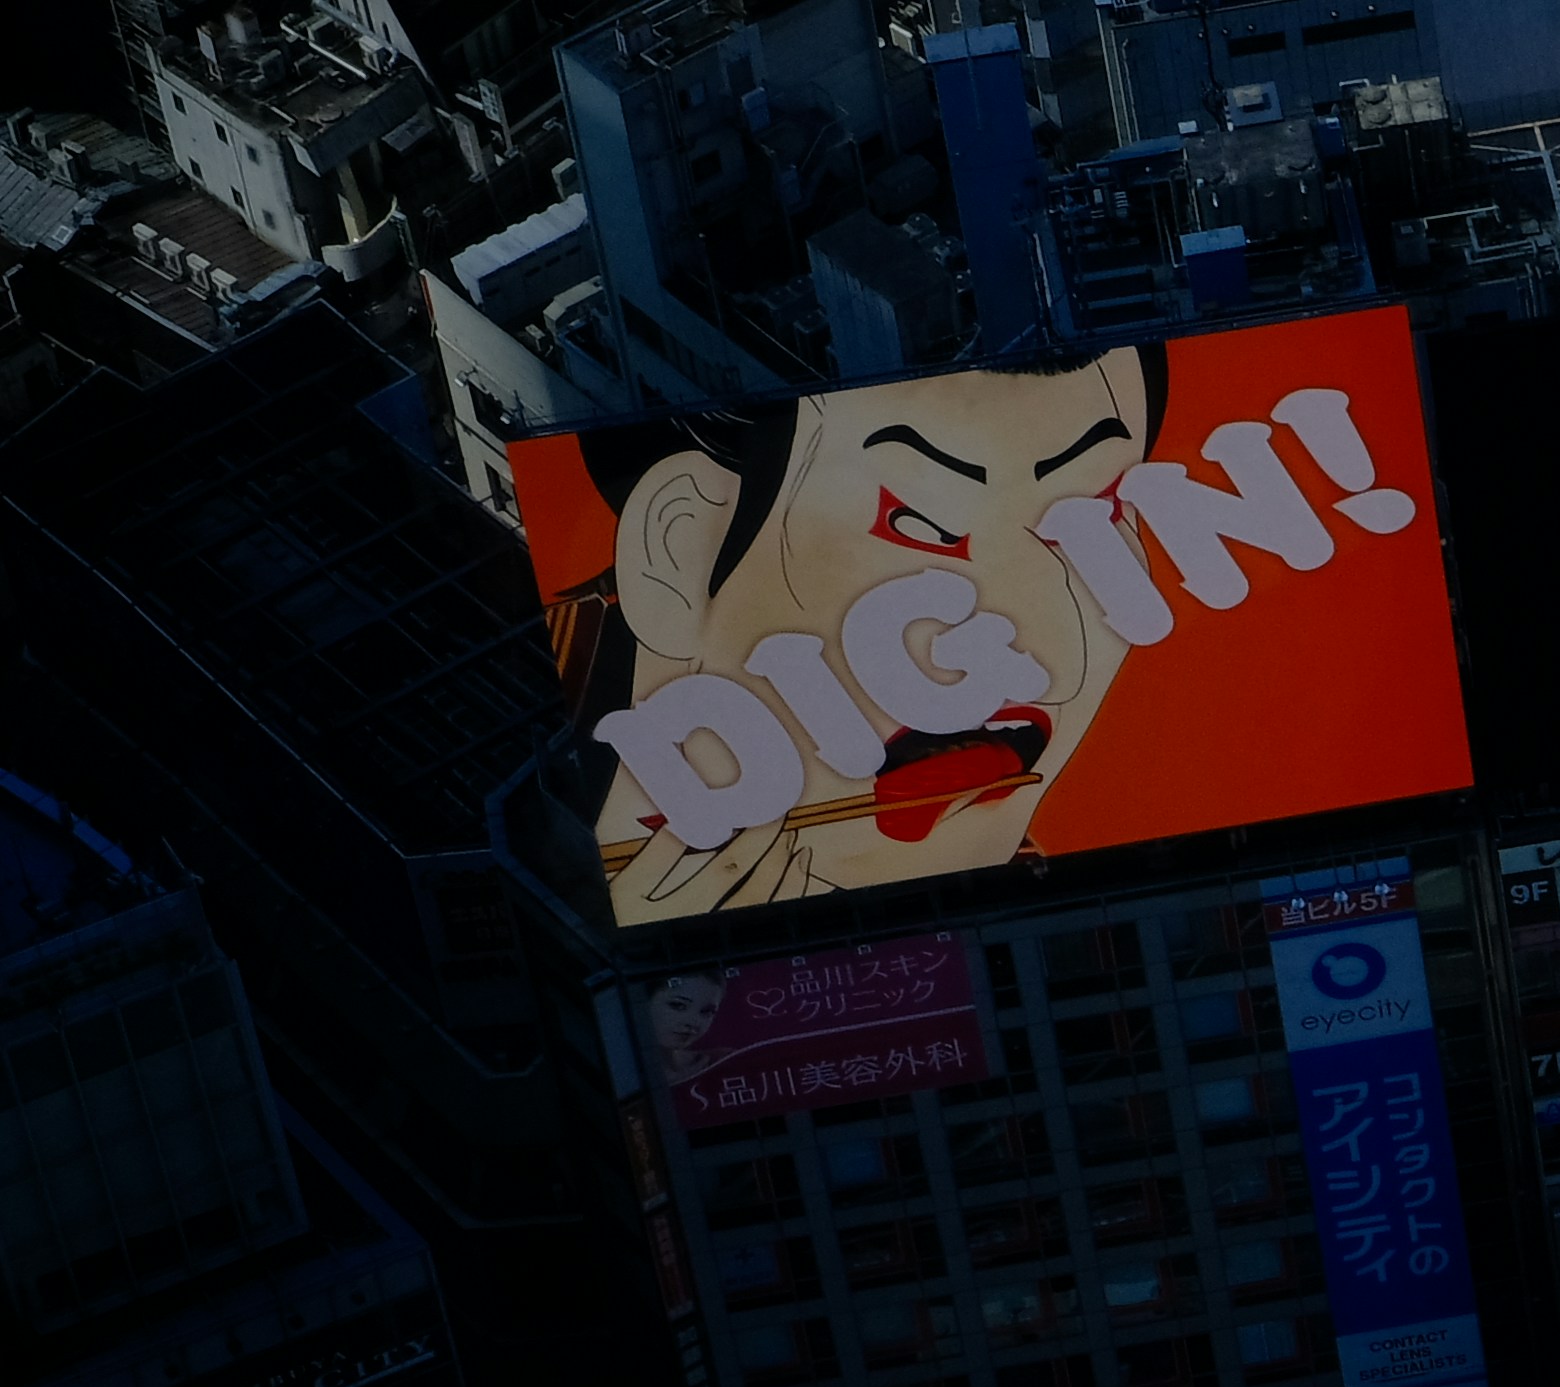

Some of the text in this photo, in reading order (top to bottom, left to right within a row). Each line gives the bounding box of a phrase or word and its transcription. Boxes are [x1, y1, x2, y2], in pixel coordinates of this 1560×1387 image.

[593, 387, 1416, 849] DIG IN!
[1281, 889, 1398, 926] 当ビル5F
[1510, 880, 1549, 905] 9F
[790, 951, 950, 997] 品川スキン
[796, 979, 936, 1023] クリニック
[1301, 998, 1412, 1034] eyecity
[717, 1037, 969, 1109] 品川美容外科
[1312, 1080, 1397, 1283] アイシティ
[1383, 1071, 1450, 1276] コンタクトの
[1369, 1328, 1449, 1353] CONTACT
[1389, 1346, 1432, 1363] LENS
[1358, 1352, 1467, 1382] SPECIALISTS
